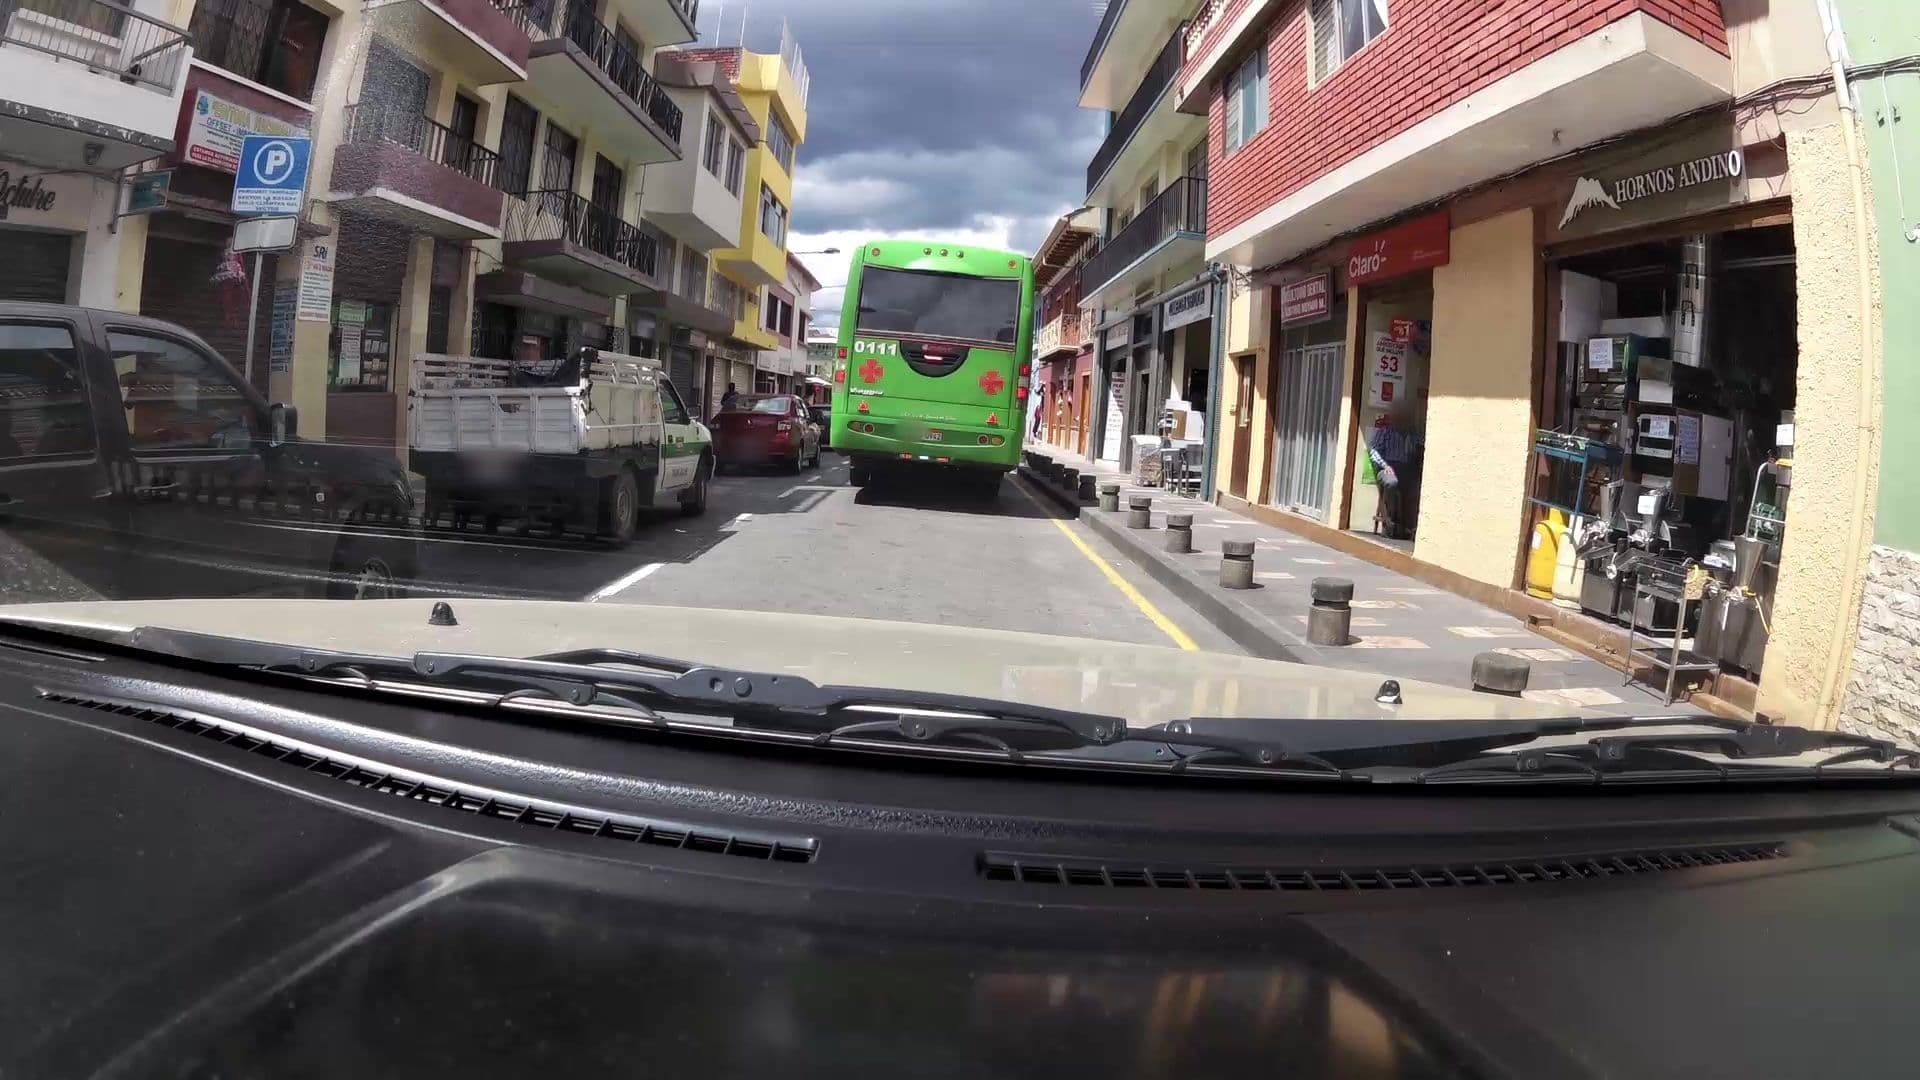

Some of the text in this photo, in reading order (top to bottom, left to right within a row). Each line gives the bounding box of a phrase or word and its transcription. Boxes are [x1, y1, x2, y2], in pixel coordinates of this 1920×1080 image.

[206, 116, 232, 132] OFFSET
[265, 150, 287, 175] P
[1615, 150, 1741, 203] HORNOS ANDINO
[1349, 251, 1381, 278] Claro
[855, 341, 896, 356] 0111
[1380, 355, 1399, 372] $3
